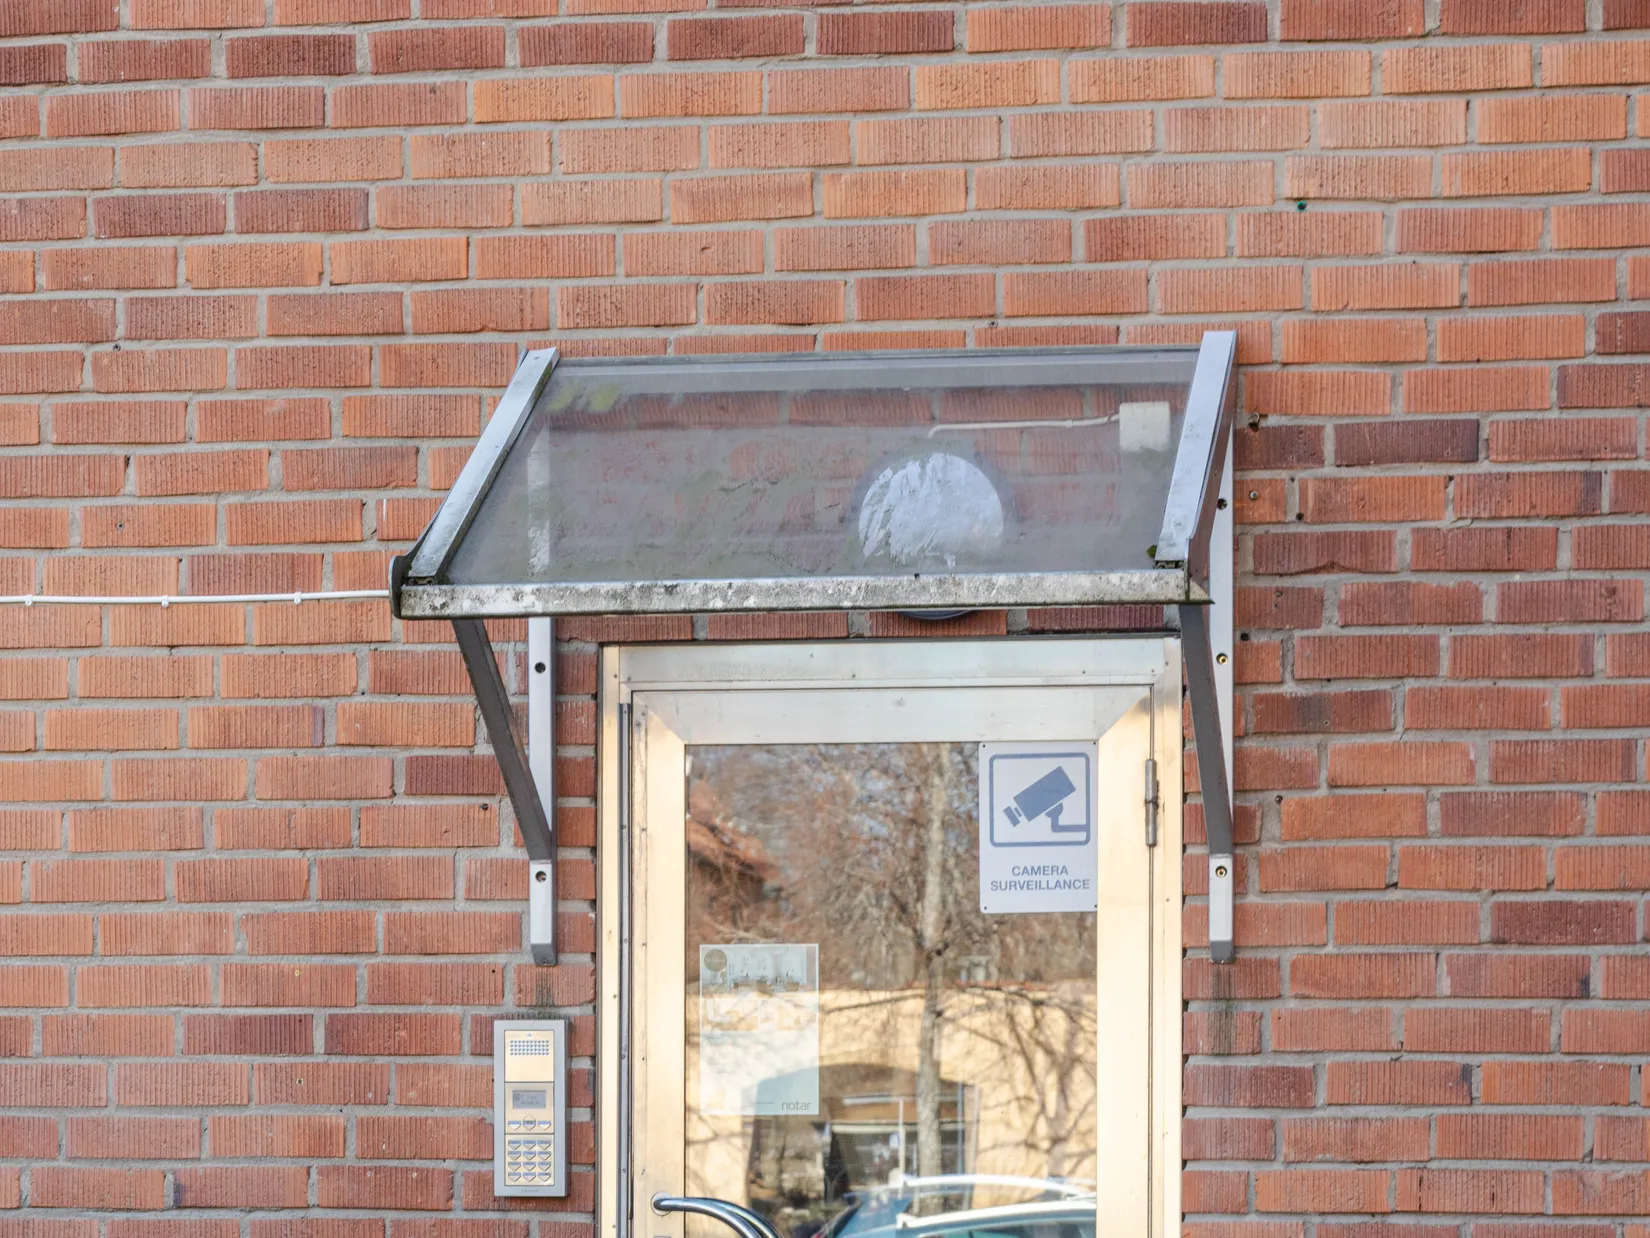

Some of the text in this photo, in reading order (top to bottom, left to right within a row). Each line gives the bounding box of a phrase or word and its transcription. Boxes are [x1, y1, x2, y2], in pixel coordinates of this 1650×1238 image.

[1012, 865, 1068, 876] CAMERA
[990, 879, 1091, 891] SURVEILLANCE
[781, 1100, 811, 1111] notar
